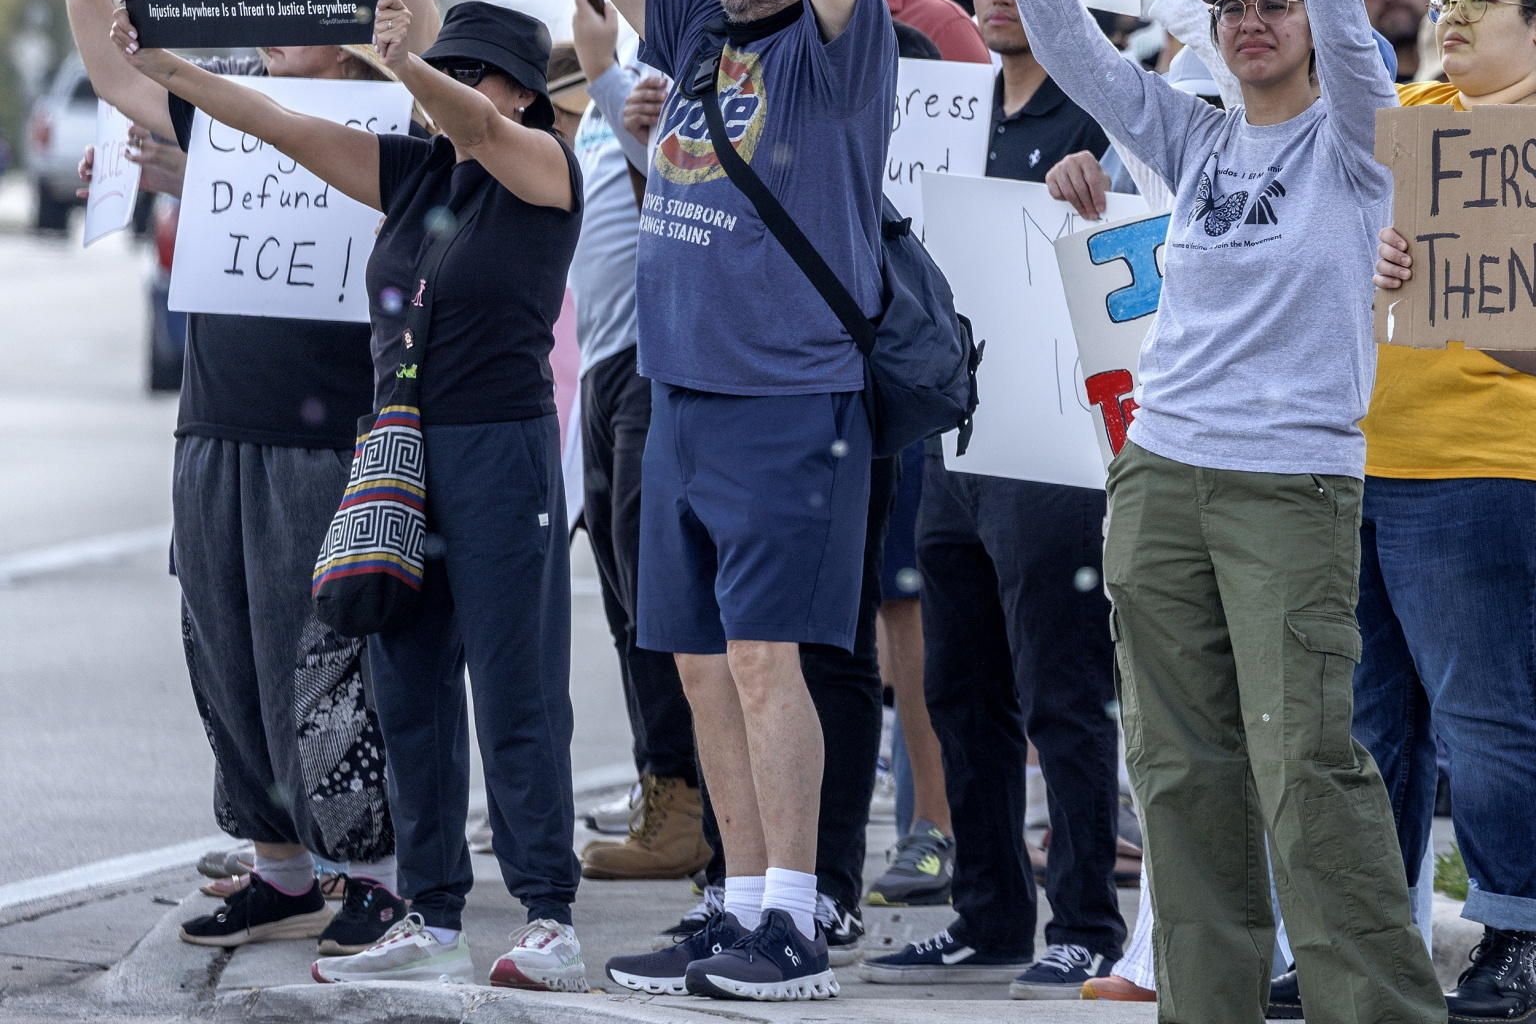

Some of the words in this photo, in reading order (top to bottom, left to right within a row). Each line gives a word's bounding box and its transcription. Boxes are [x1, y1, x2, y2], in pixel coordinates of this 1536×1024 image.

[149, 3, 180, 18] Injustice
[182, 2, 220, 18] Anywhere
[222, 3, 230, 17] Is
[231, 6, 237, 17] a
[238, 1, 264, 16] Threat
[267, 2, 275, 15] to
[277, 1, 305, 16] Justice
[307, 0, 357, 18] Everywhere
[211, 174, 329, 214] Defund
[665, 198, 738, 232] STUBBORN
[667, 222, 712, 247] STAINS
[1230, 239, 1243, 248] the
[1243, 233, 1283, 248] Movement
